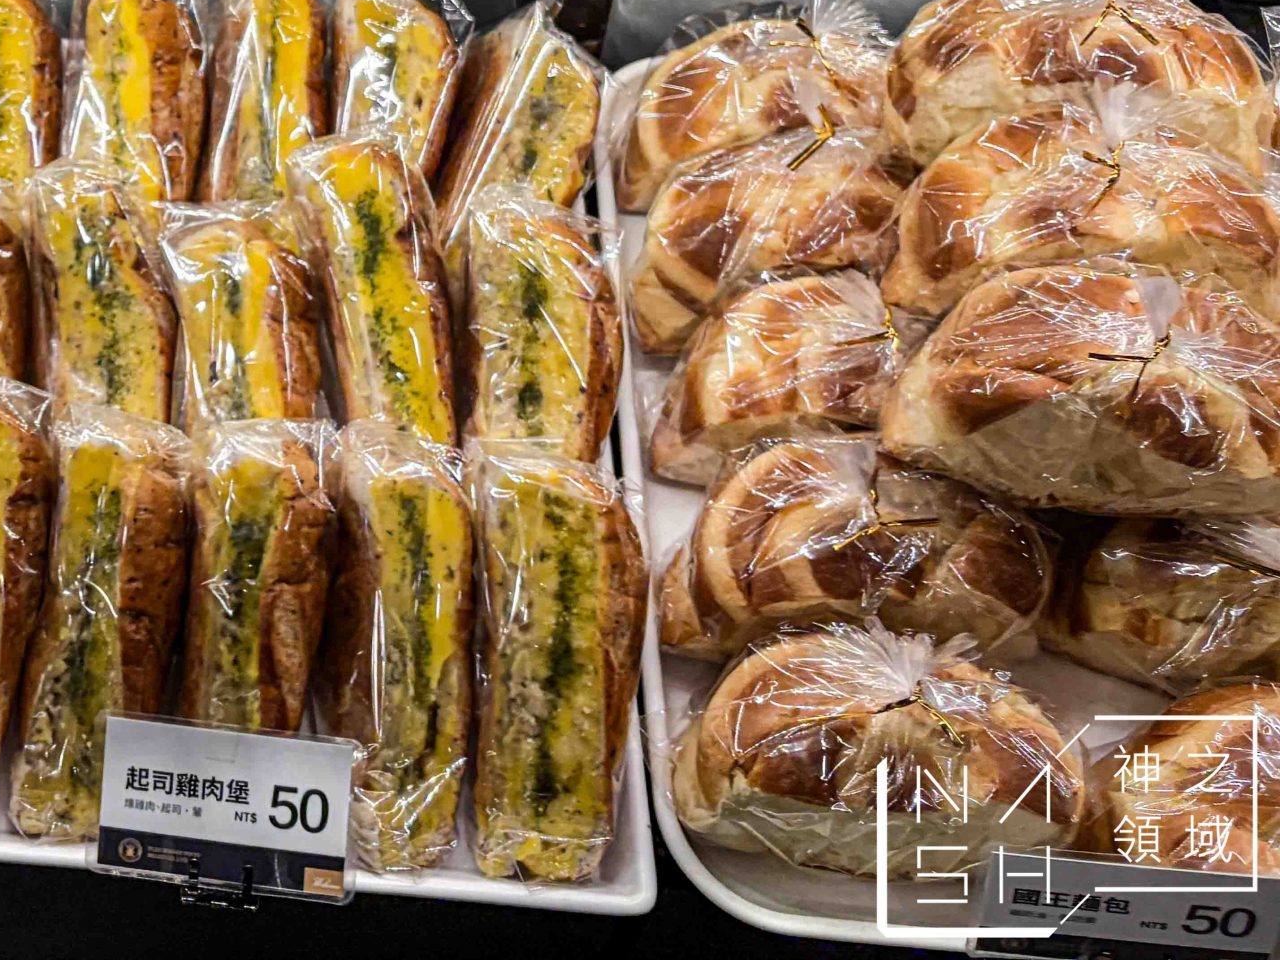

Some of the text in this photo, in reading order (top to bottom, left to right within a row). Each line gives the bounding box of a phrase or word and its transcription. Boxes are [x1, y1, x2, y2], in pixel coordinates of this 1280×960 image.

[125, 766, 250, 805] 起司雞肉堡
[234, 784, 329, 833] NT$ 50
[1013, 888, 1130, 915] 國王麵包
[1182, 905, 1257, 938] 50
